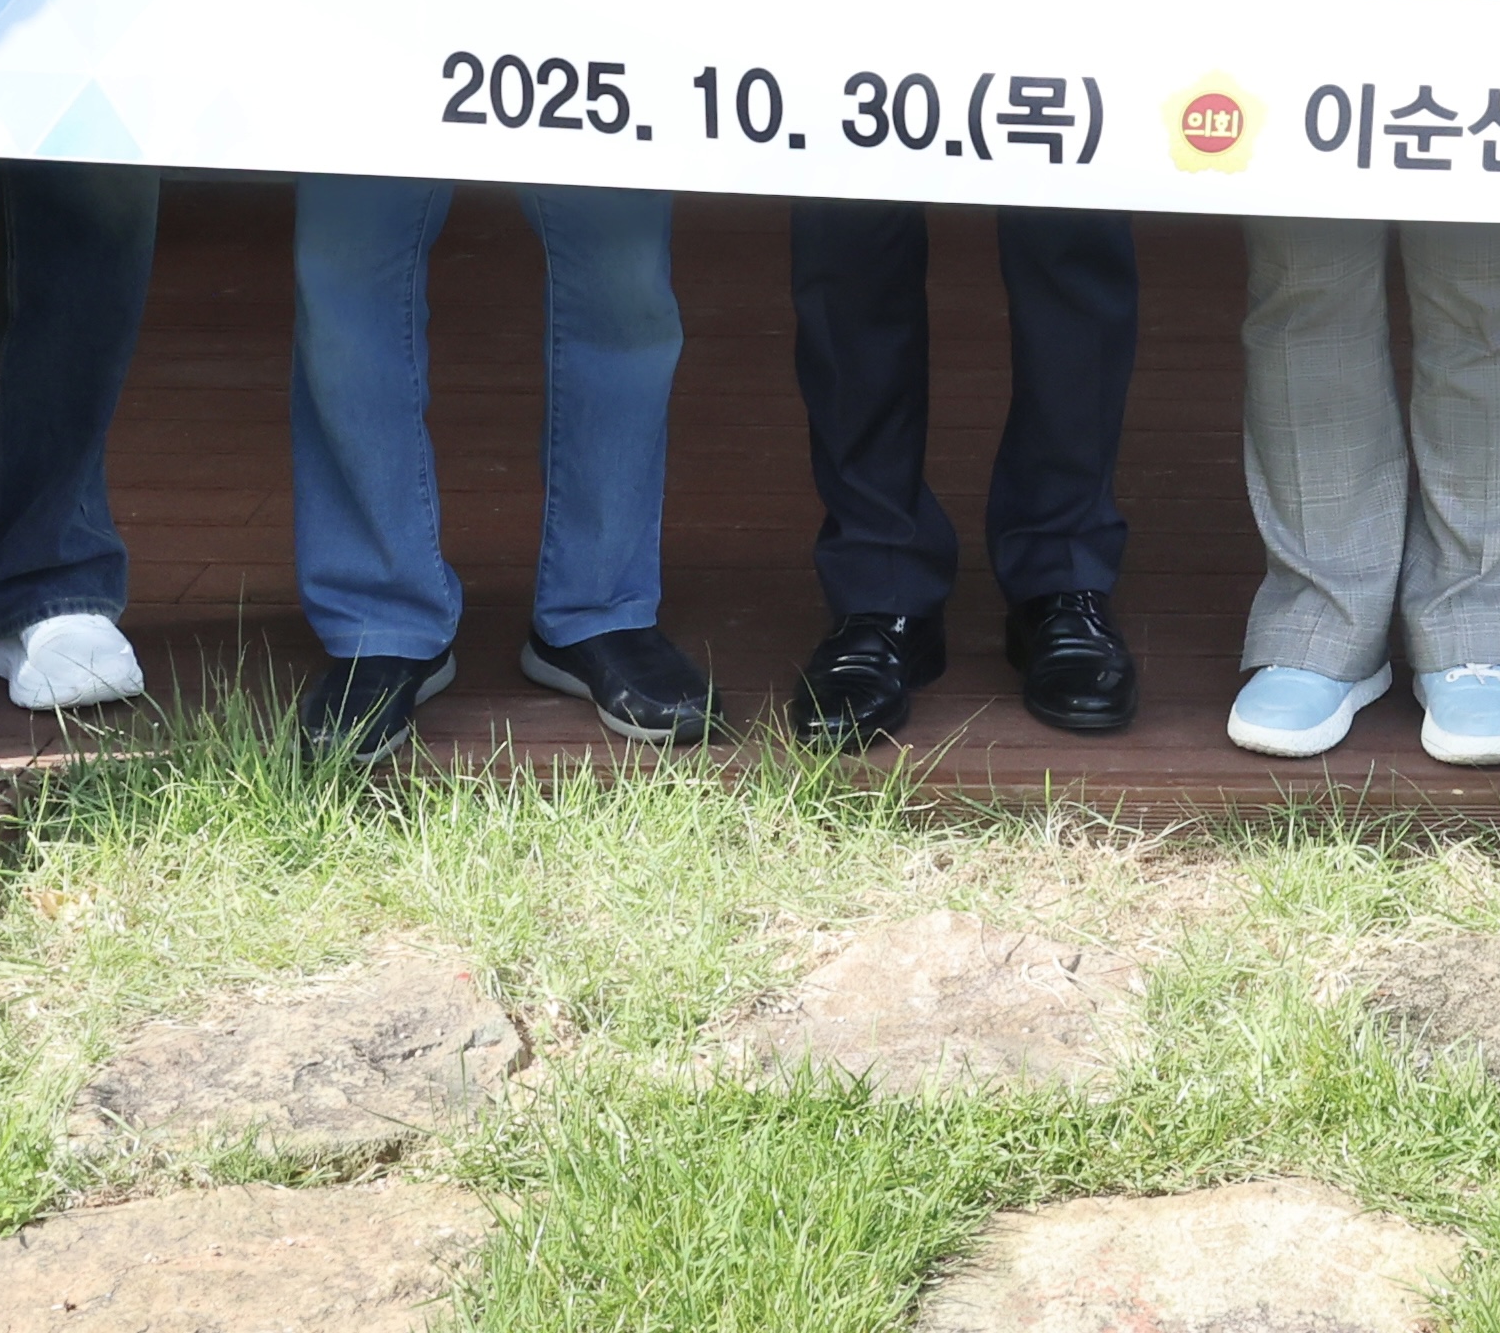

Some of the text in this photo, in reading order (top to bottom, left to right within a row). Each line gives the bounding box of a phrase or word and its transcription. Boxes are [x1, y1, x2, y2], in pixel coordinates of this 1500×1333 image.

[439, 49, 1106, 165] 2025. 10. 30.(목)
[1184, 108, 1240, 139] 의회
